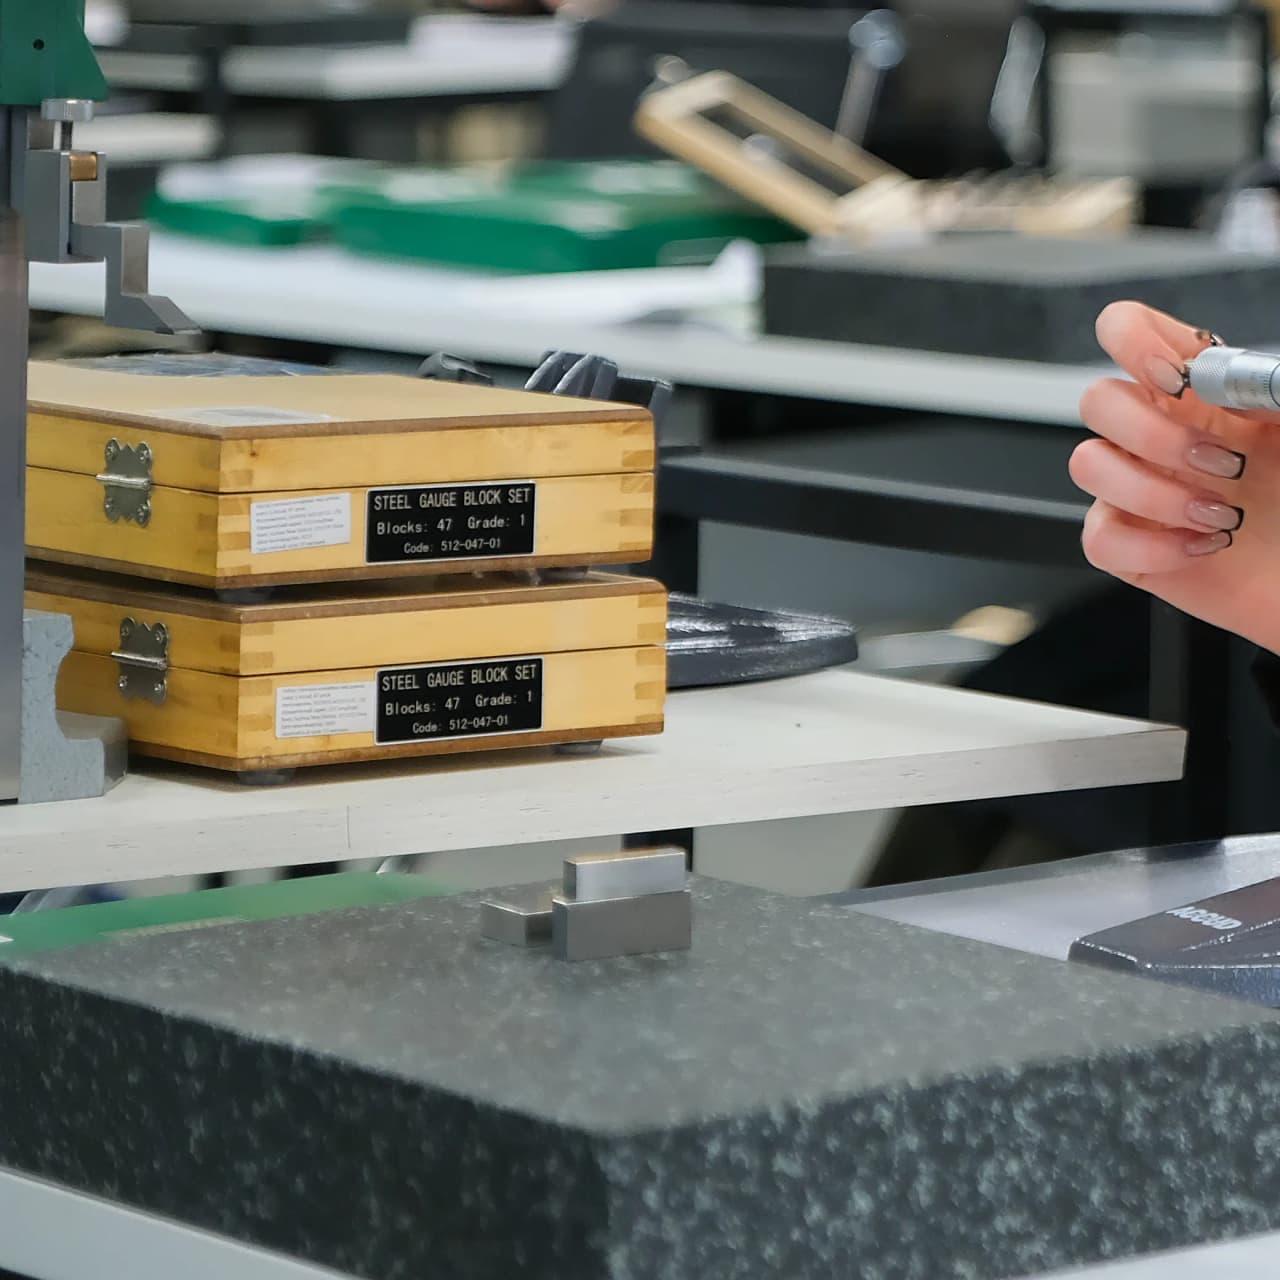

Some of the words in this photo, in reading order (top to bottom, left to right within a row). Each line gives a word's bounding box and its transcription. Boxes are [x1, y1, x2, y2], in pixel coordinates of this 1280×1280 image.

[374, 494, 412, 511] STEEL
[419, 491, 457, 509] GAUGE
[463, 489, 501, 506] BLOCK
[508, 488, 530, 504] SET
[376, 521, 428, 535] Blocks:
[437, 518, 452, 532] 47
[467, 515, 510, 529] Grade:
[404, 542, 433, 554] Code:
[441, 538, 501, 552] 512-047-01
[382, 674, 420, 691] STEEL
[427, 670, 464, 688] GAUGE
[471, 666, 508, 684] BLOCK
[515, 664, 537, 680] SET
[385, 701, 436, 716] Blocks:
[445, 697, 460, 711] 47
[475, 693, 518, 707] Grade:
[413, 721, 442, 734] Code:
[449, 715, 508, 730] 512-047-01
